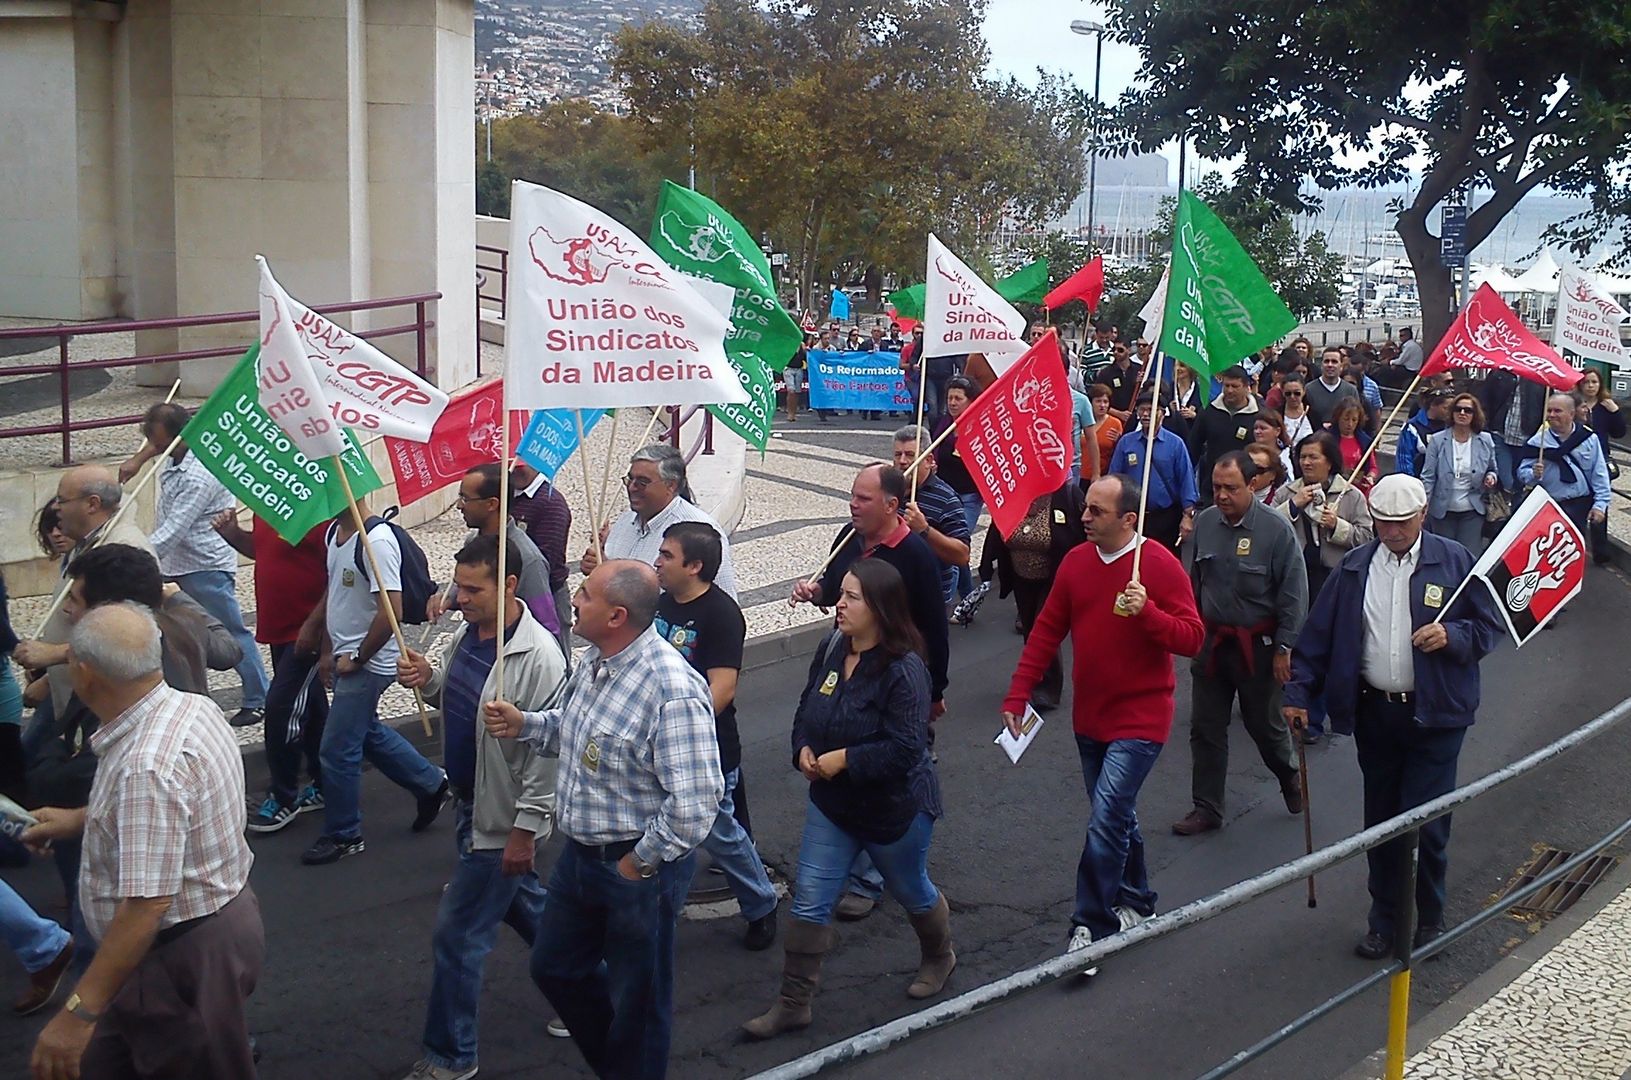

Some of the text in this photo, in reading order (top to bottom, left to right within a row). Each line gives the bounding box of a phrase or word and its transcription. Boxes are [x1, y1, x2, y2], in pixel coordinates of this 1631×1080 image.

[1443, 208, 1454, 224] P
[1441, 238, 1454, 254] P
[547, 298, 686, 330] União dos
[546, 329, 699, 354] Sindicatos
[943, 330, 963, 342] da
[1175, 326, 1194, 348] da
[336, 363, 432, 407] CGTP
[541, 360, 713, 384] da Madeira
[837, 364, 906, 376] Reformados
[235, 394, 292, 453] União
[218, 410, 313, 502] Sindicatos
[1010, 442, 1028, 477] dos
[1033, 416, 1066, 470] CGTP
[200, 431, 223, 458] da
[222, 454, 295, 521] Madeir
[969, 436, 1006, 510] Madeira
[1538, 520, 1581, 578] STAL
